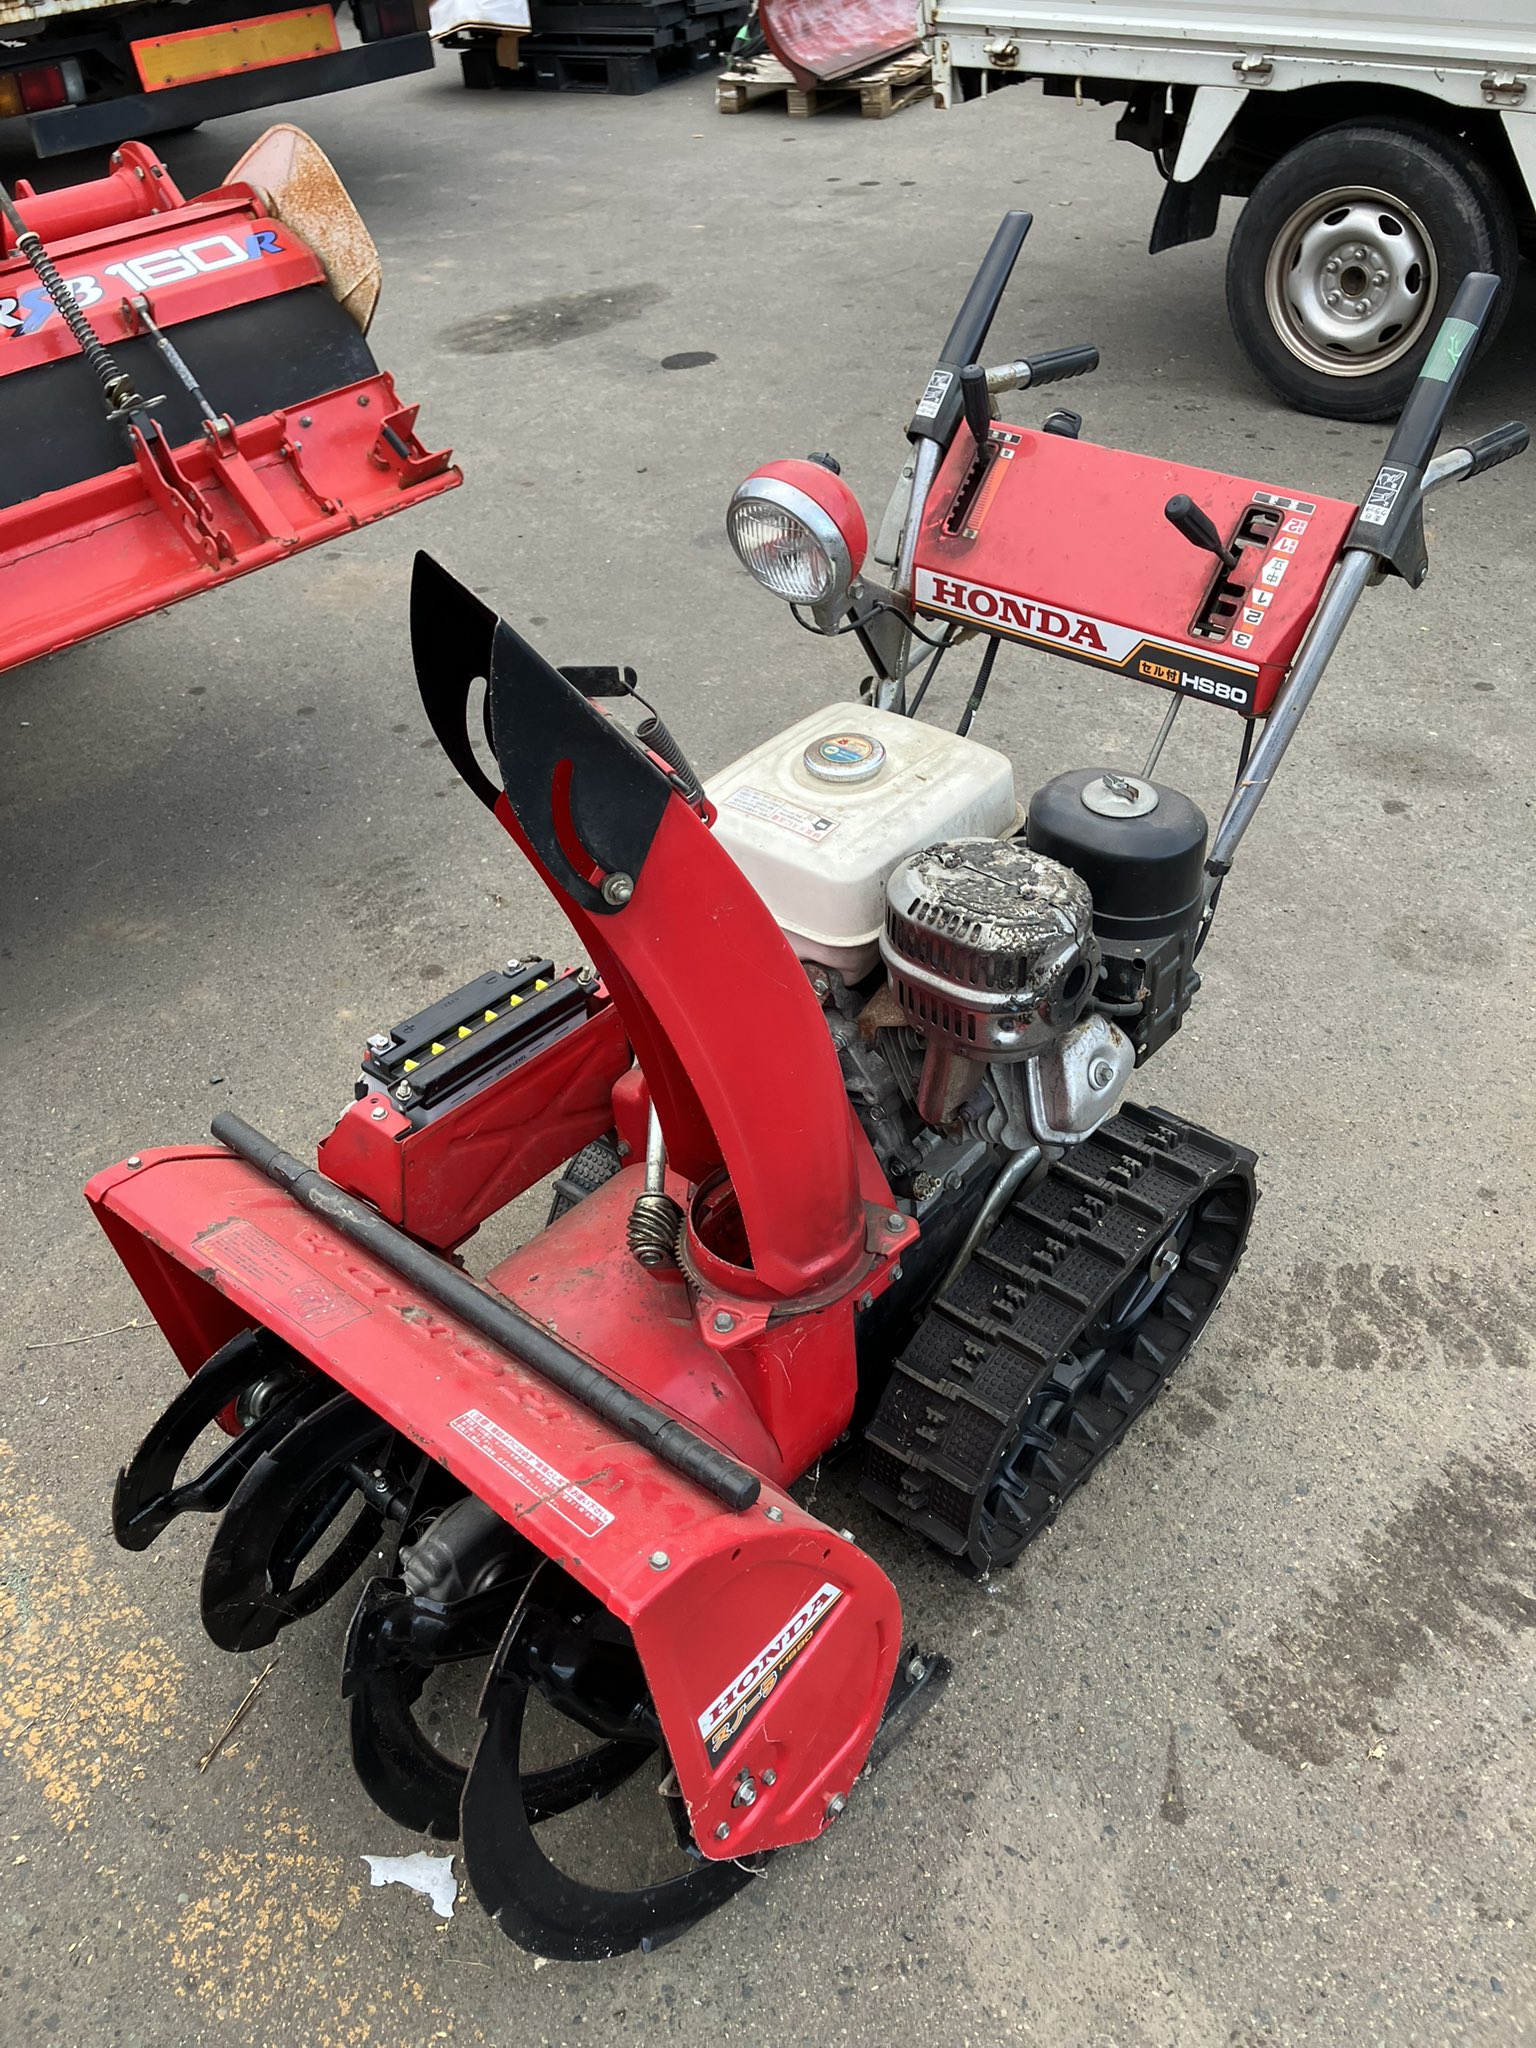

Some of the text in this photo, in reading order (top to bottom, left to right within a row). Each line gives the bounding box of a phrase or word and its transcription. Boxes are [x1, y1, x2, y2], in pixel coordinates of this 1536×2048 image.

[1266, 558, 1285, 583] 中立
[931, 576, 1108, 652] HONDA
[1246, 610, 1262, 623] 2
[1235, 632, 1250, 646] 3
[1141, 661, 1248, 704] セル付 HS80
[709, 1592, 833, 1726] HONDA
[779, 1629, 815, 1671] HS80
[711, 1671, 778, 1753] スノーラ
